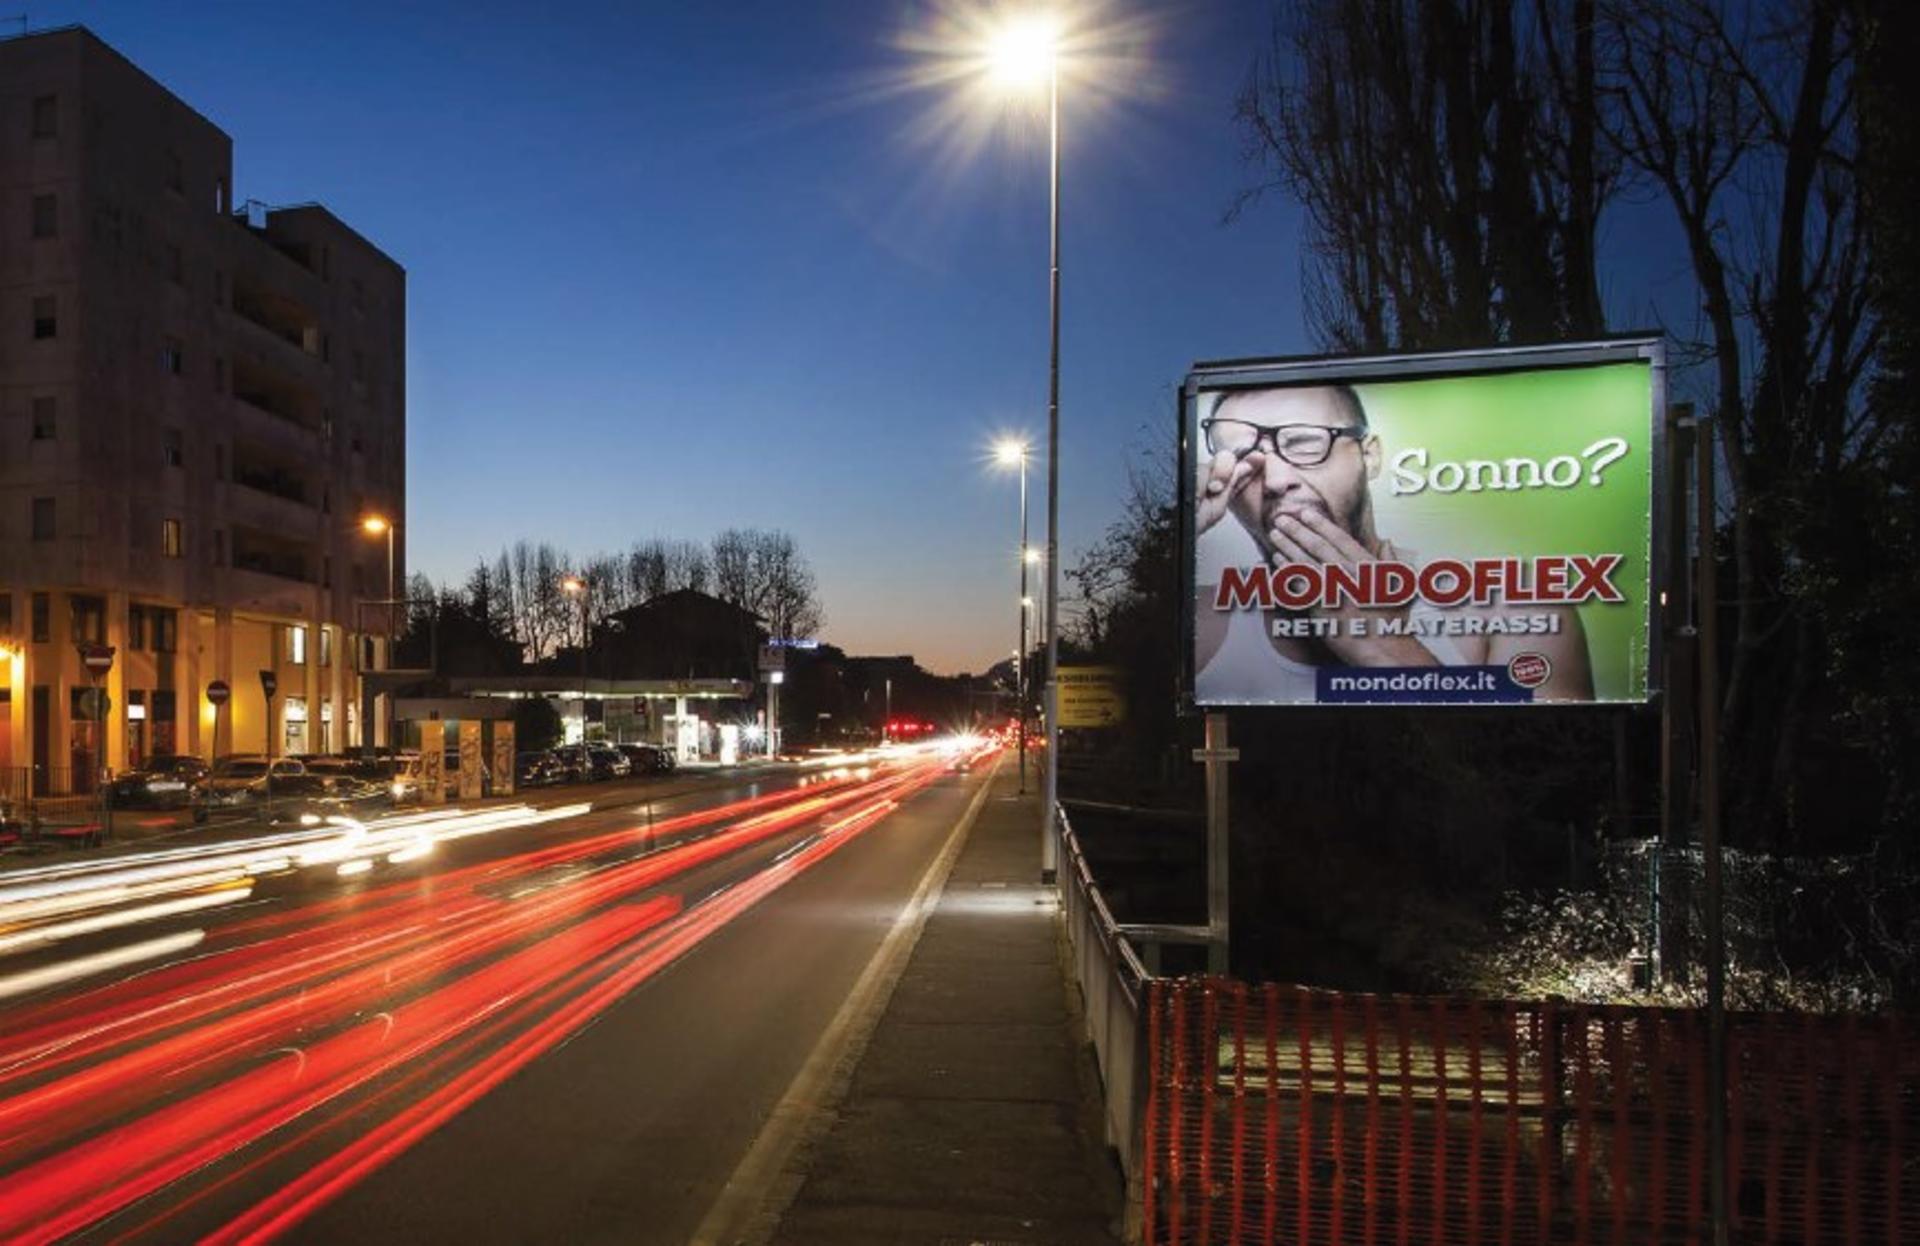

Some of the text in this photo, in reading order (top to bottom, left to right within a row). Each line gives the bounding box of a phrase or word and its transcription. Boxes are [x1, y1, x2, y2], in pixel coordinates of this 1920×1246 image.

[1391, 437, 1629, 496] Sonno?
[1213, 553, 1626, 612] MONDOFLEX
[1271, 613, 1561, 638] RETI E MATERASSI
[1330, 671, 1496, 692] mondoflex.it
